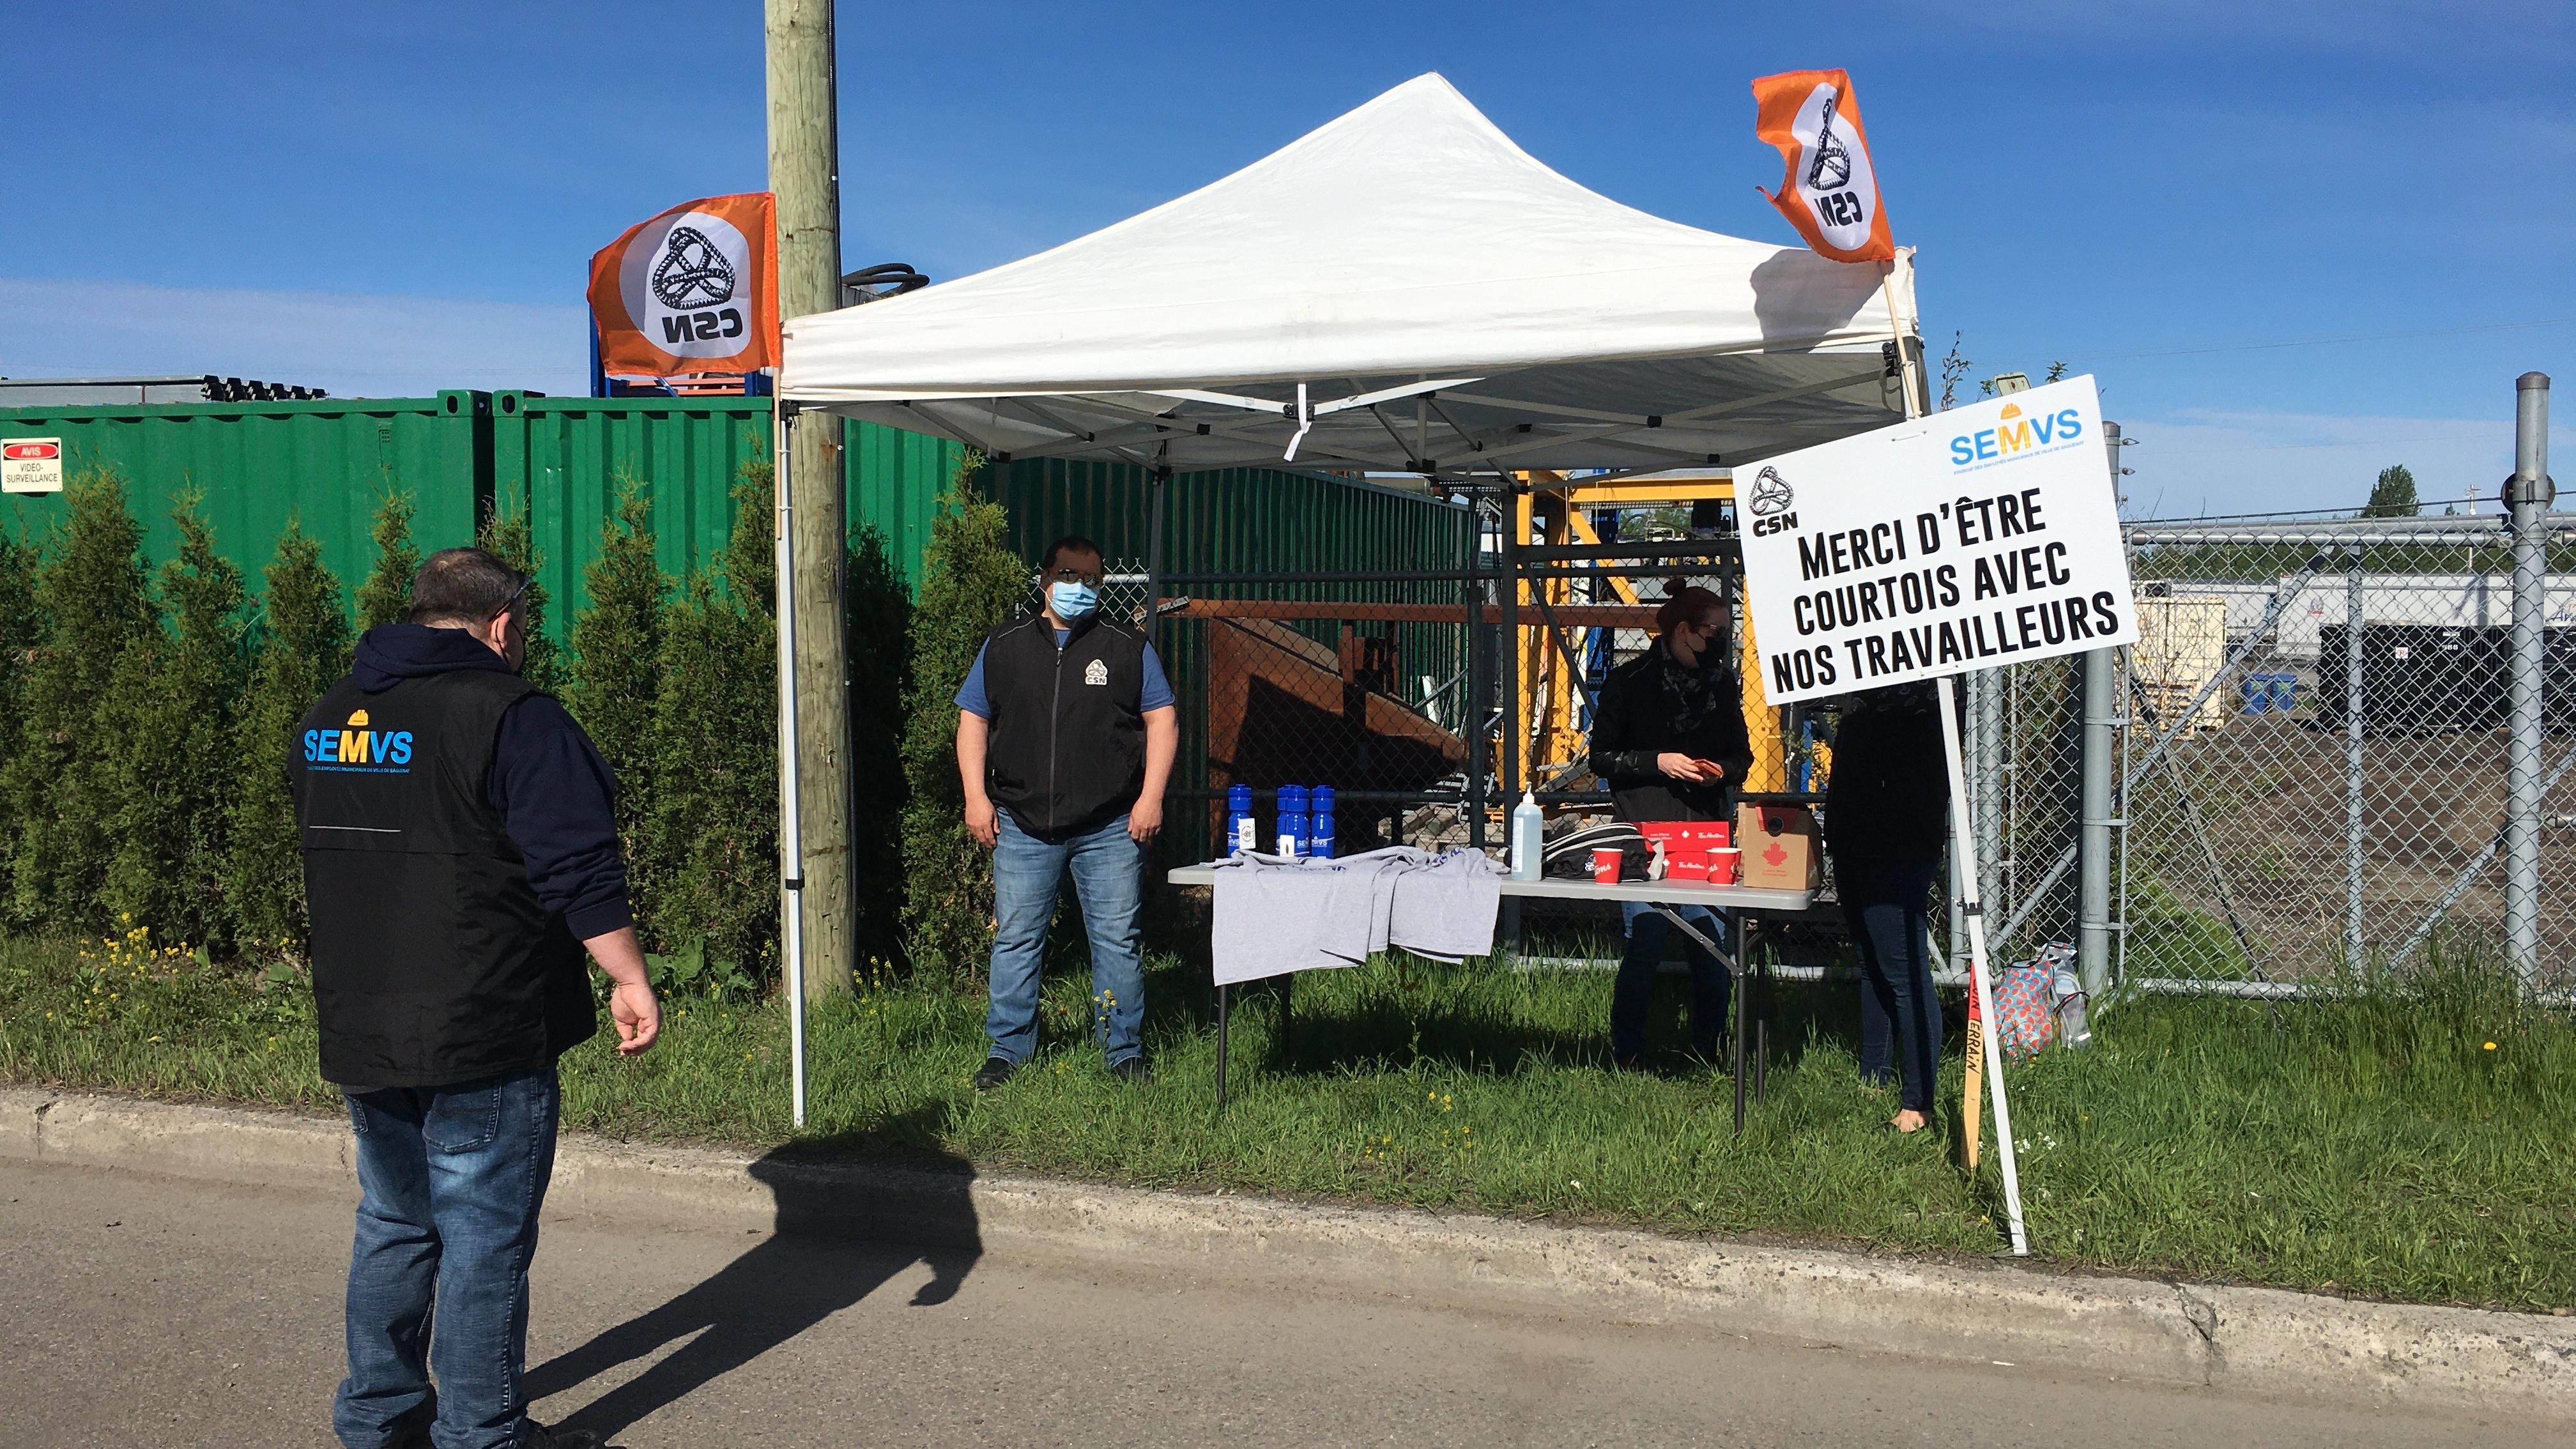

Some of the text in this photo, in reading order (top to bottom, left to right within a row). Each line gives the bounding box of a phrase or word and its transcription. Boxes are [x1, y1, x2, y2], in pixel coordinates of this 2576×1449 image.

[20, 447, 42, 456] AVIS
[1950, 409, 2082, 466] SEMVS
[6, 473, 58, 483] SURVEILLANCE
[20, 461, 43, 471] VIDÉO-
[1752, 511, 1798, 537] CSN
[1797, 519, 1906, 581] MERCI
[1793, 541, 2071, 636] COURTOIS AVEC
[1771, 591, 2119, 694] NOS TRAVAILLEURS
[304, 729, 413, 764] SEMVS
